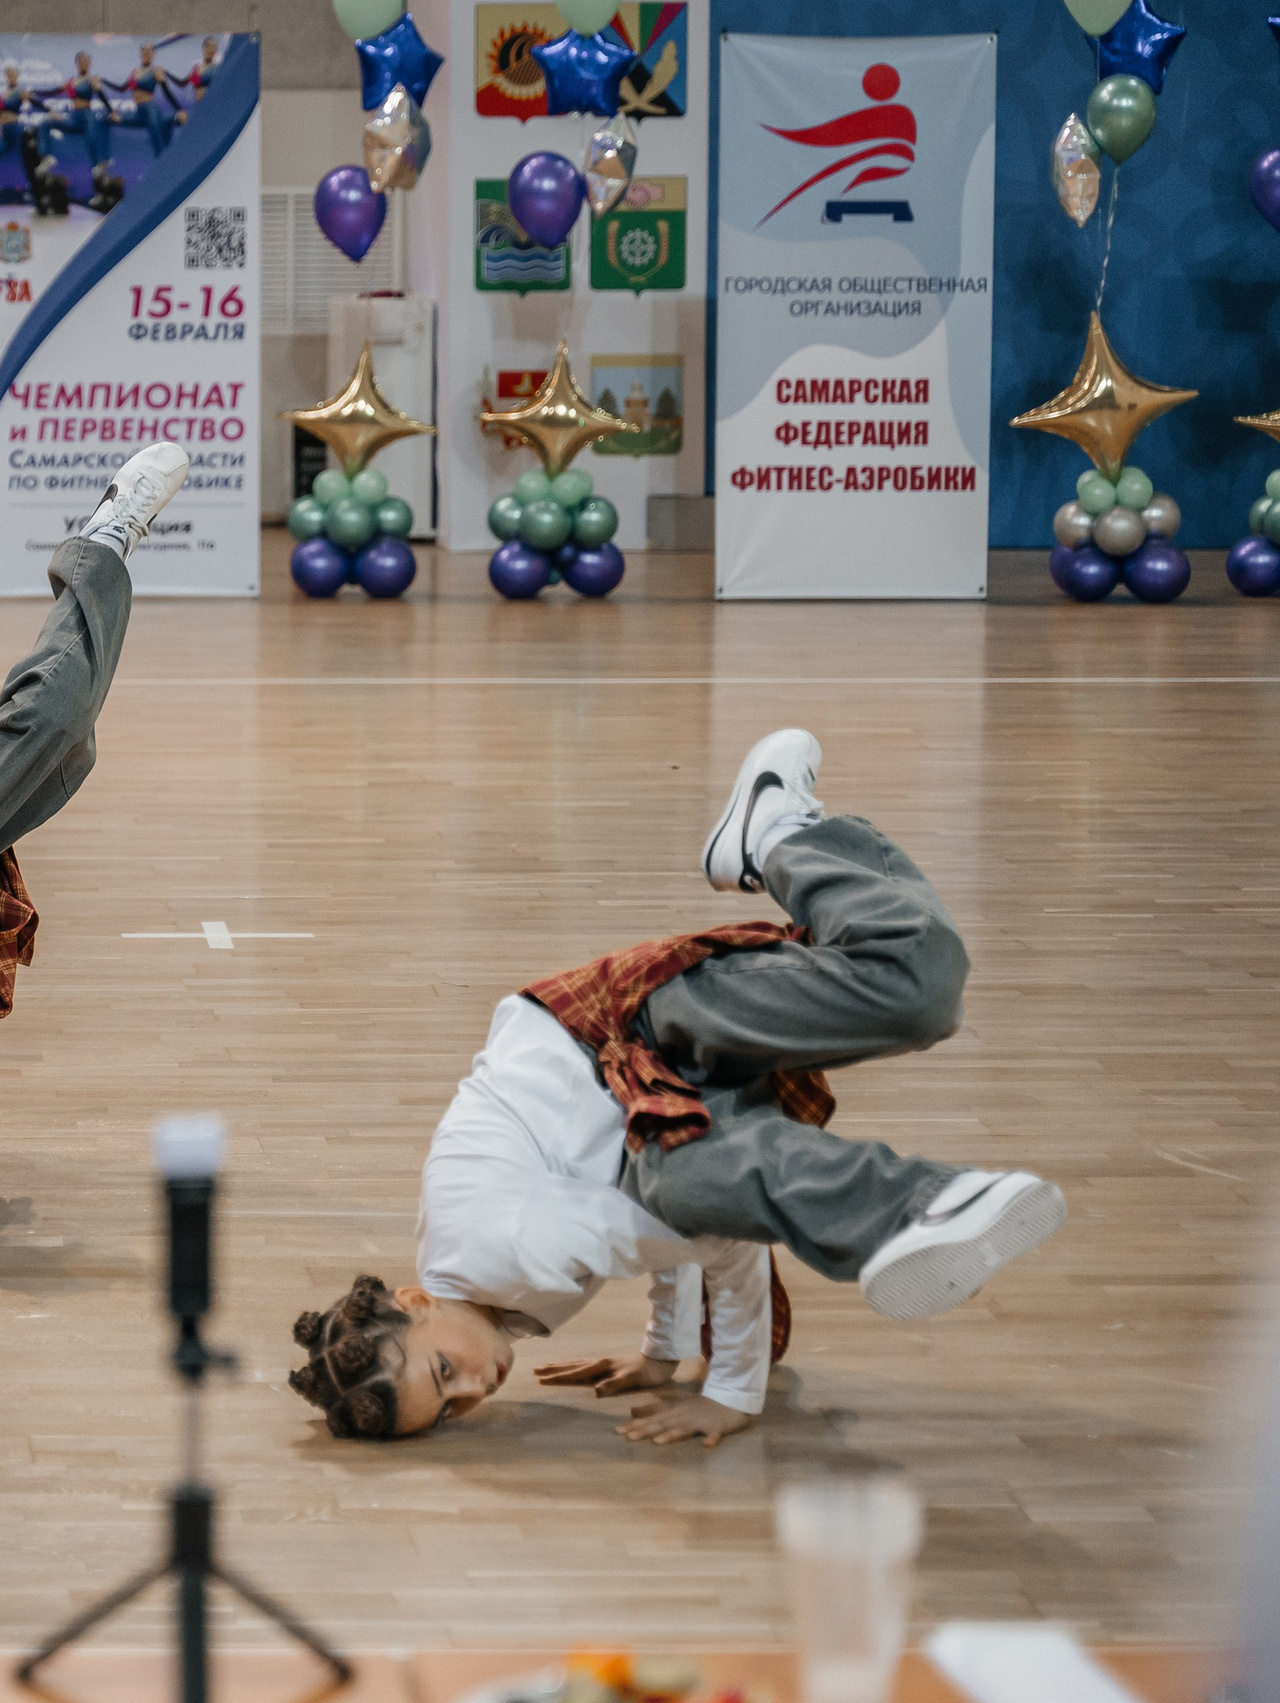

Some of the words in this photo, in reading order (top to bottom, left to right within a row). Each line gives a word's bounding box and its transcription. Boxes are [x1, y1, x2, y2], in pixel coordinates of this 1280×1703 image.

[724, 276, 832, 296] ГОРОДСКАЯ
[838, 276, 987, 296] ОБЩЕСТВЕННАЯ
[130, 285, 245, 318] 15-16
[789, 300, 922, 318] ОРГАНИЗАЦИЯ
[128, 322, 245, 341] ФЕВРАЛЯ
[9, 382, 245, 409] ЧЕМПИОНАТ
[776, 378, 929, 404] САМАРСКАЯ
[38, 418, 245, 441] ПЕРВЕНСТВО
[775, 421, 929, 449] ФЕДЕРАЦИЯ
[8, 475, 37, 490] ПО
[731, 466, 976, 491] ФИТНЕС-АЭРОБИКИ
